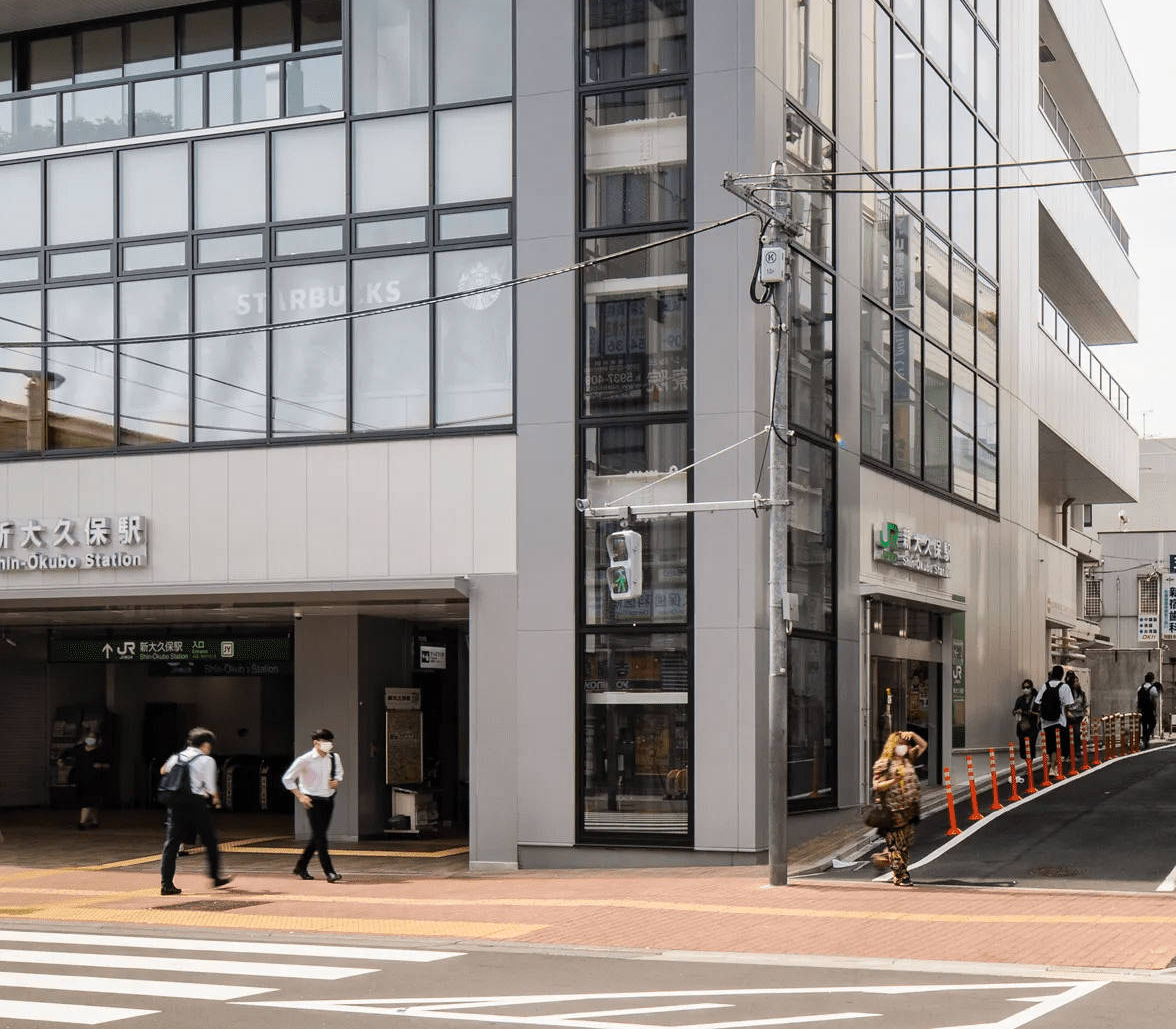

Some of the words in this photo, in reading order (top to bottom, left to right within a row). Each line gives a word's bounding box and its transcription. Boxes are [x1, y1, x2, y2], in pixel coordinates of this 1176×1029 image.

[236, 279, 402, 316] STRBUKS
[903, 528, 951, 563] 新大久保駅
[85, 550, 142, 569] Station
[117, 641, 136, 655] JR
[139, 641, 183, 653] 新大久保駅
[192, 641, 205, 649] 入口
[251, 664, 279, 674] Station
[953, 665, 963, 680] JR
